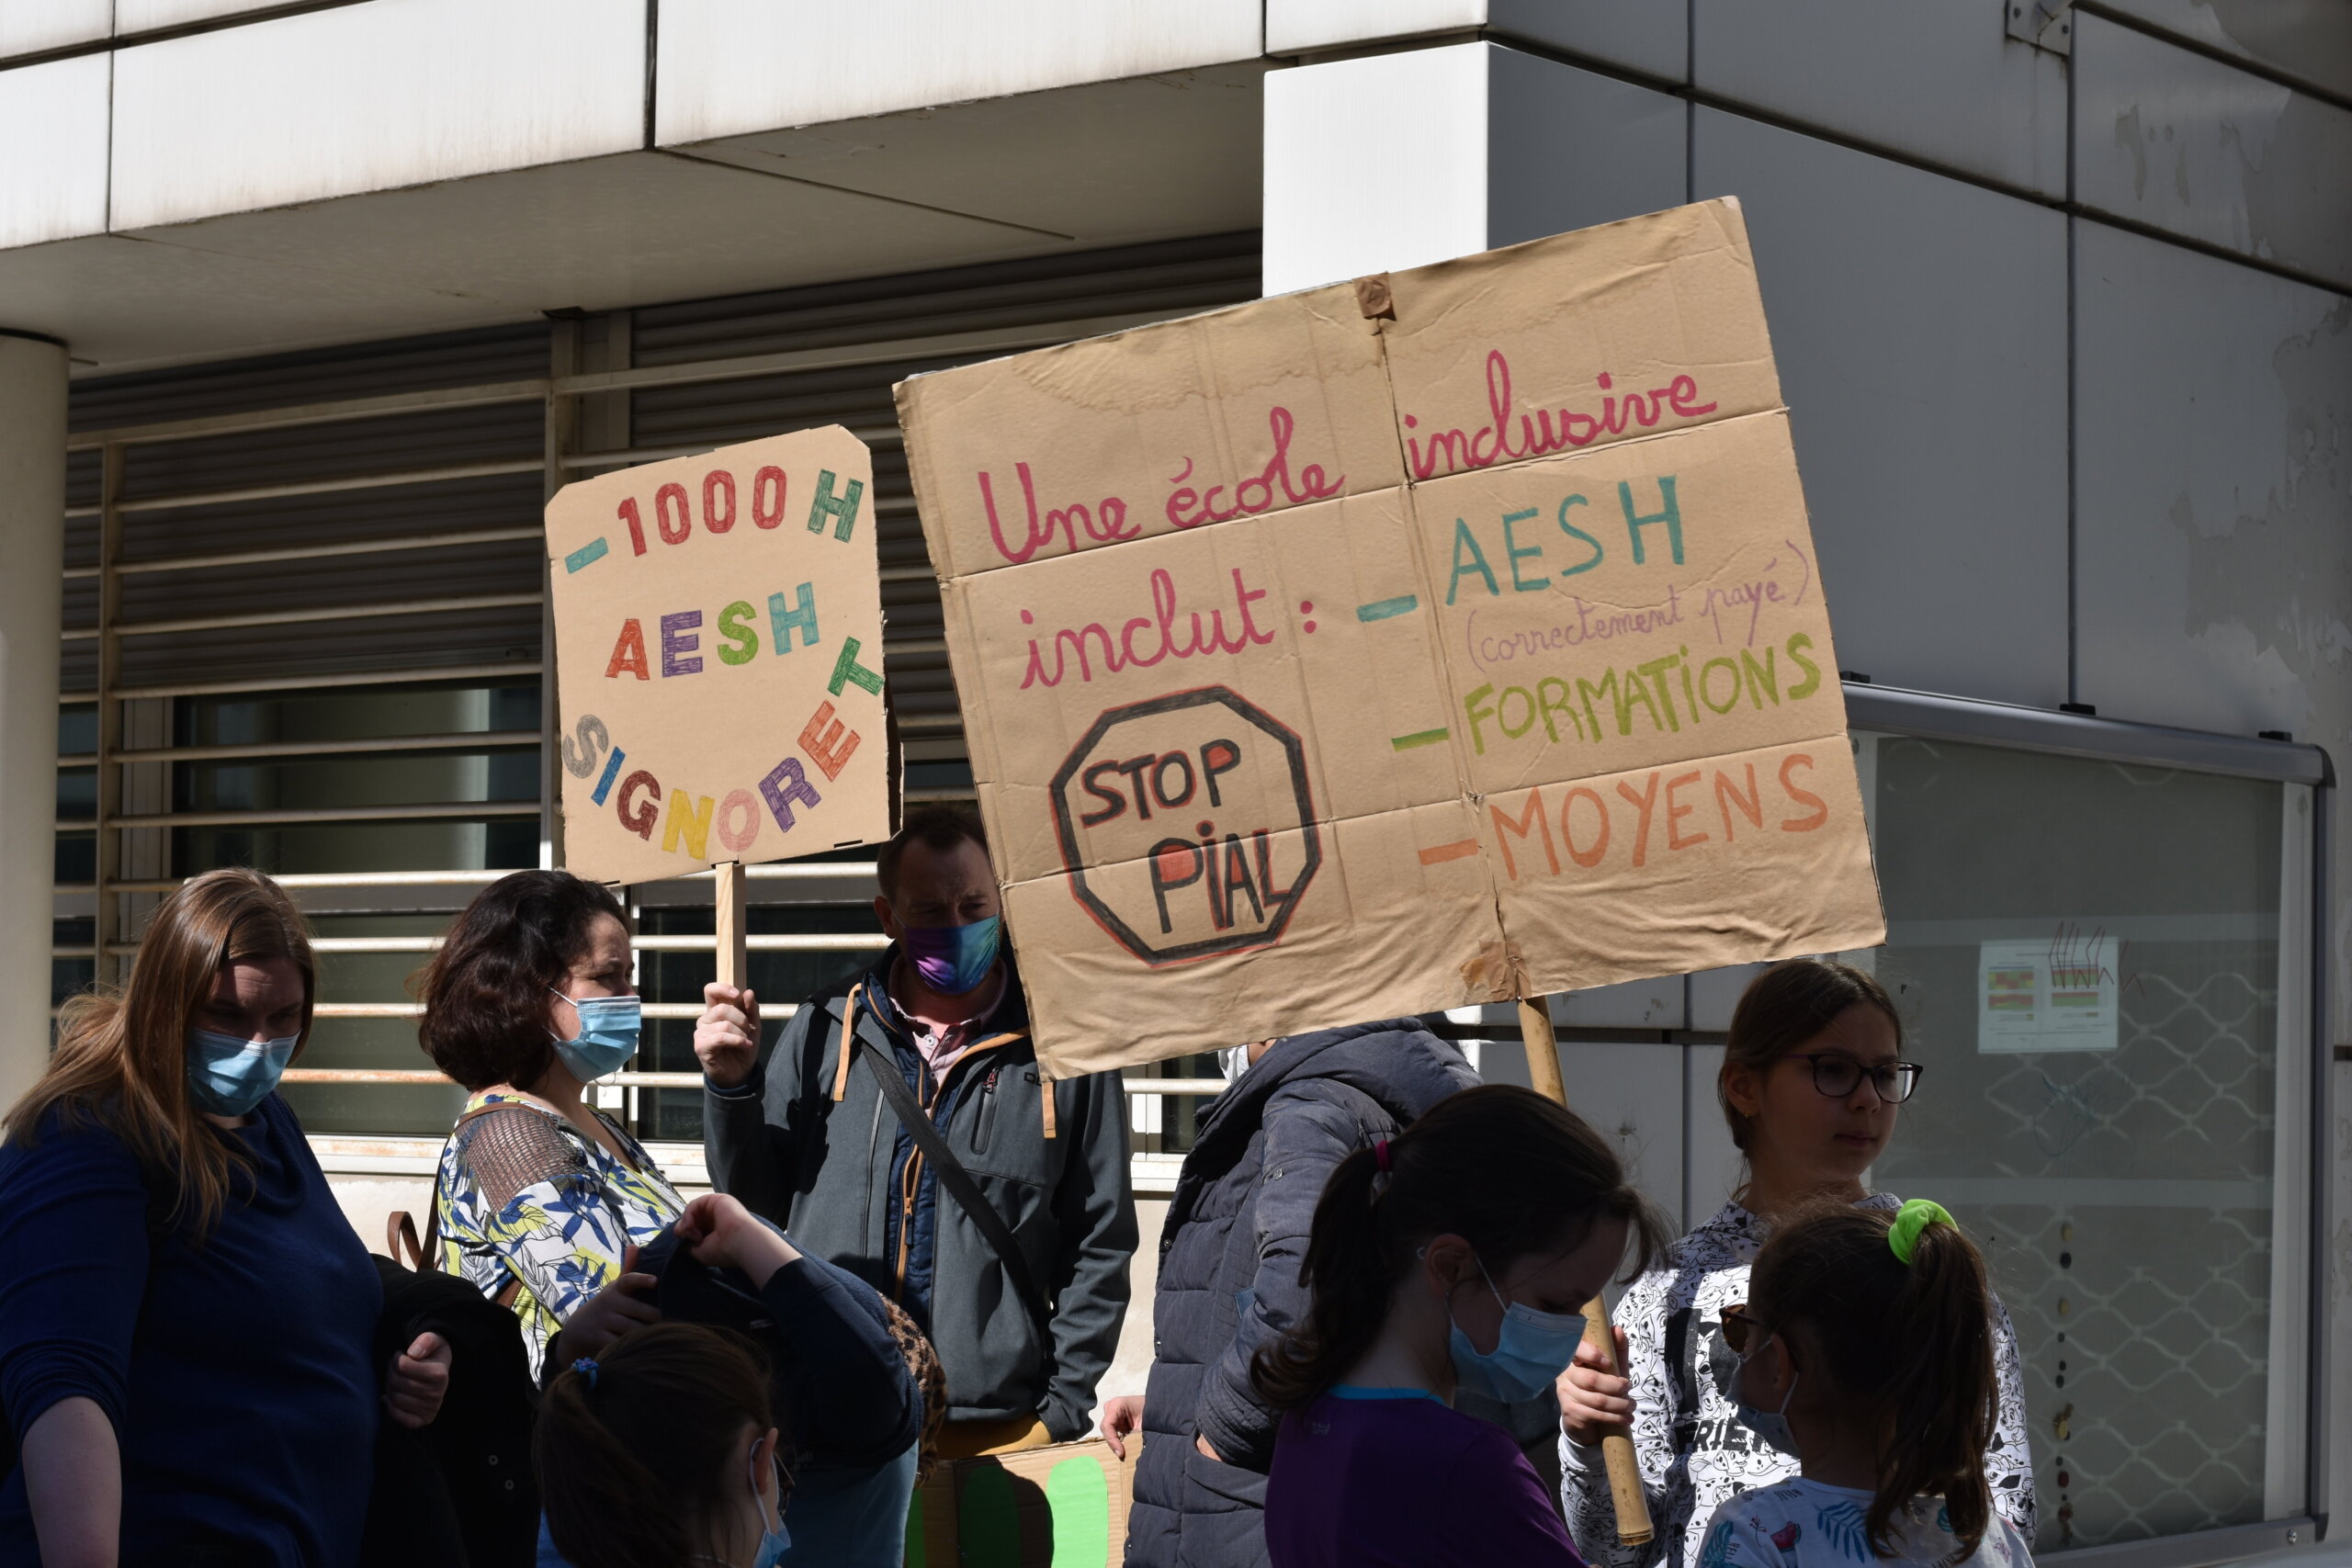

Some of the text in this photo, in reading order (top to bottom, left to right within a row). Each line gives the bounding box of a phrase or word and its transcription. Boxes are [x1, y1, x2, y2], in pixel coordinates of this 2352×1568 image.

[978, 349, 1718, 564] Une école inclusive
[1445, 475, 1685, 606] AESH
[605, 581, 820, 682] AESH
[1467, 584, 1684, 672] (correctement
[561, 636, 886, 861] SIGNORET
[1080, 739, 1241, 829] STOP
[1488, 753, 1829, 882] MOYENS
